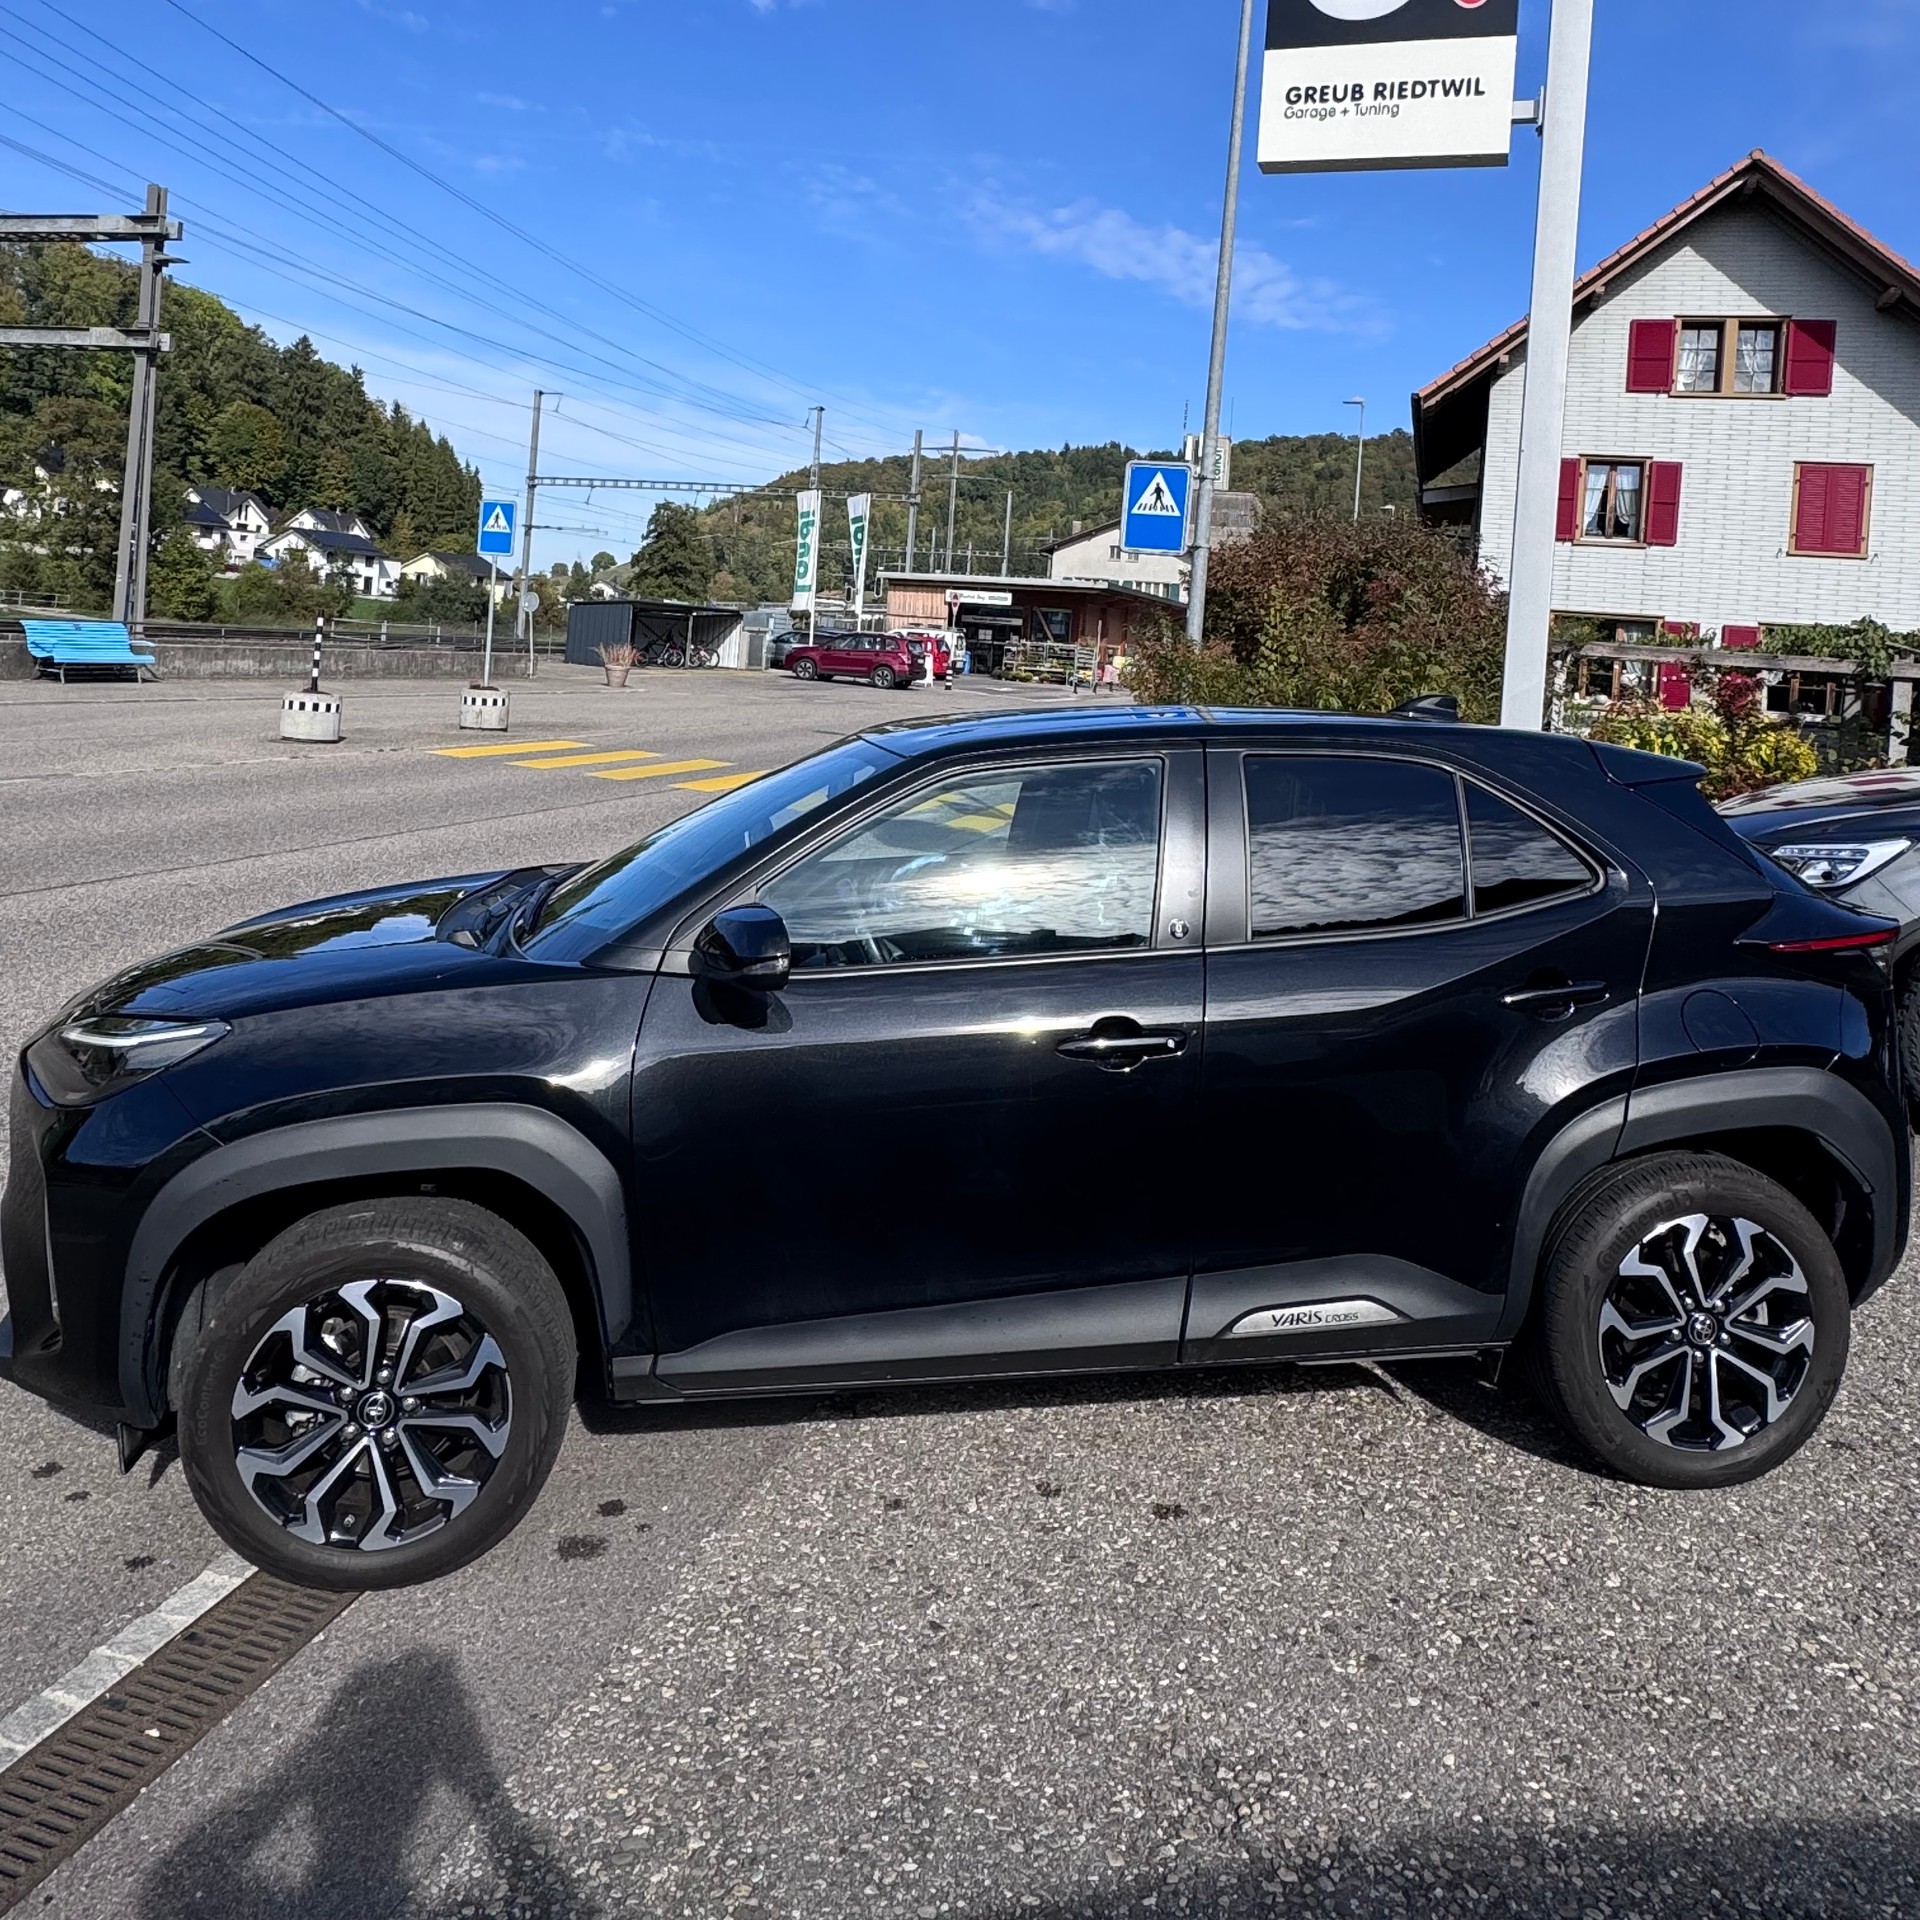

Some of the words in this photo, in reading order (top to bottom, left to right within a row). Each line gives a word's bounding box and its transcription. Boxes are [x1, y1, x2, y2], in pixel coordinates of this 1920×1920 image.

[1285, 83, 1364, 105] GREUB
[1373, 77, 1485, 101] RIEDTWIL
[1283, 106, 1336, 121] Garage
[1340, 107, 1350, 117] +
[1354, 102, 1400, 118] Tuning
[1325, 1311, 1359, 1323] CROSS
